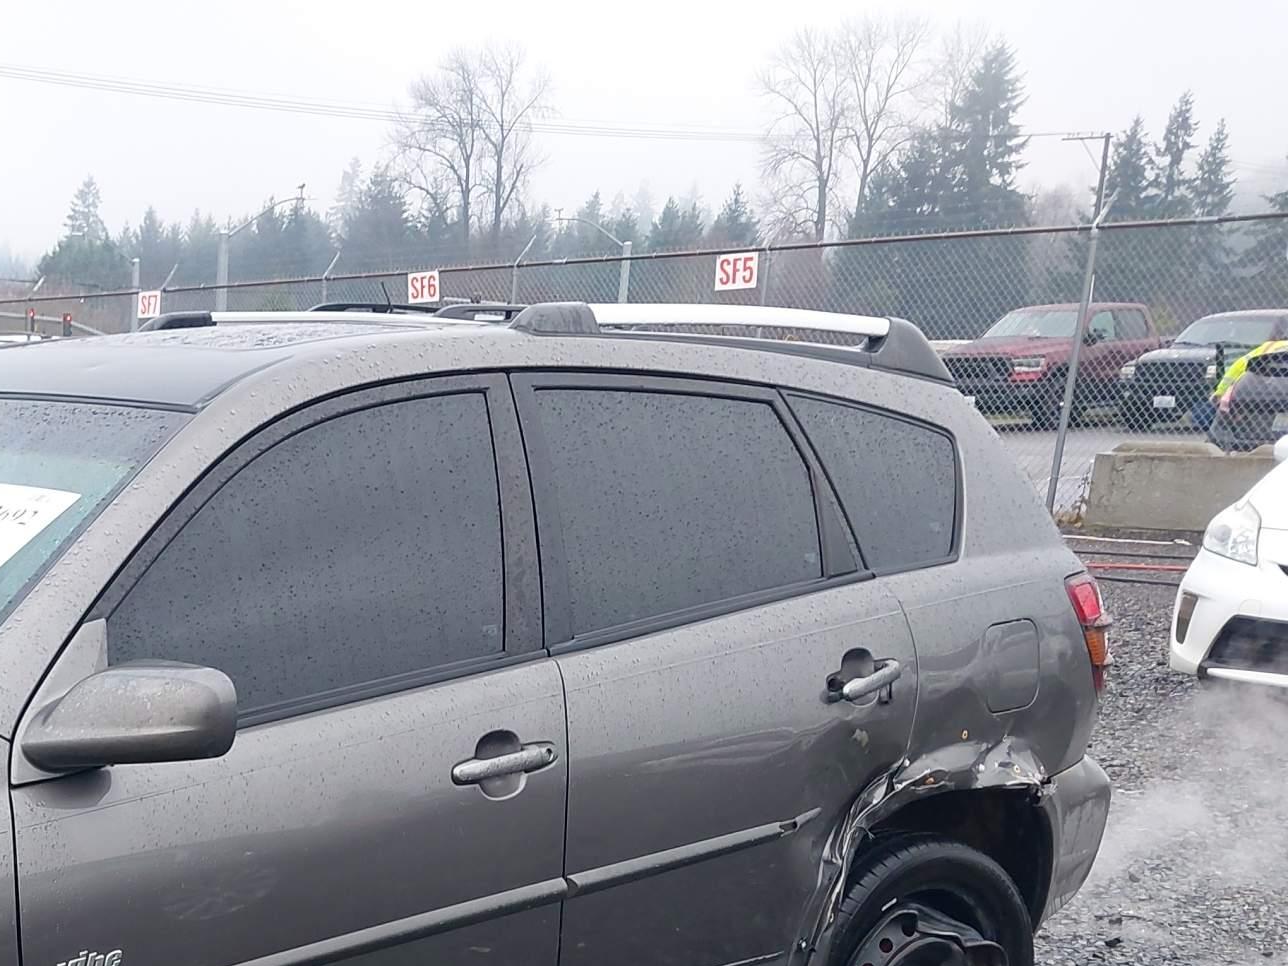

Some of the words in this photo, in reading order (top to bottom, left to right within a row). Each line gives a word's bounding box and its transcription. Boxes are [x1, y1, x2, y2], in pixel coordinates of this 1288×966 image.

[719, 256, 754, 285] SF5
[411, 274, 436, 299] SF6
[141, 294, 158, 315] SF7
